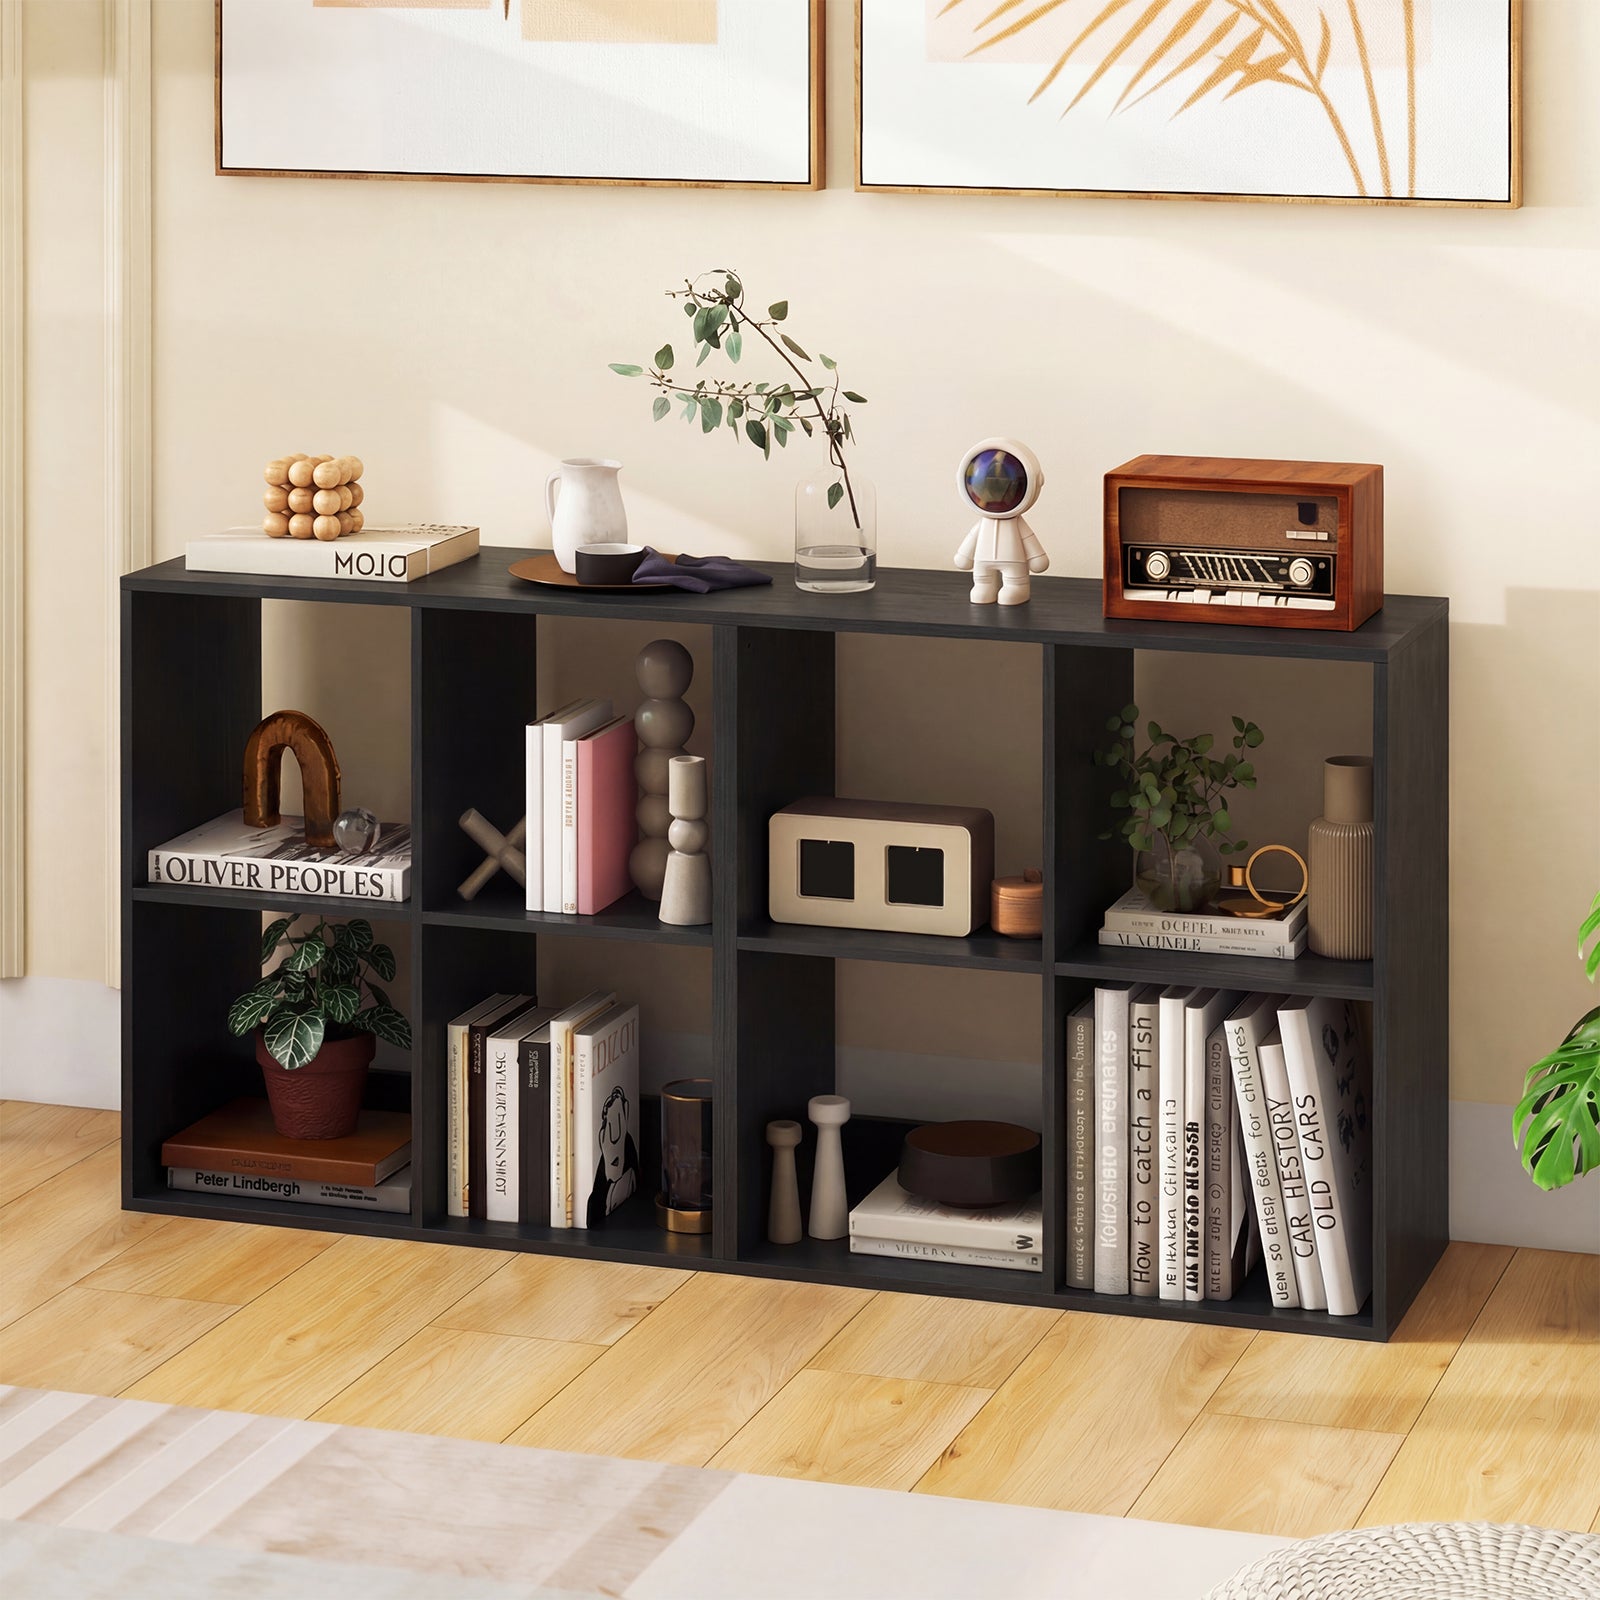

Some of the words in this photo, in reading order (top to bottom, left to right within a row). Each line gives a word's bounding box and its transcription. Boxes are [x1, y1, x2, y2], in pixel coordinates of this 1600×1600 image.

[165, 857, 263, 889] OLIVER
[270, 864, 384, 898] PEOPLES
[1132, 1016, 1152, 1071] fish
[1136, 1088, 1151, 1101] a
[1248, 1113, 1263, 1139] for
[1296, 1094, 1324, 1161] CARS
[1132, 1116, 1152, 1185] catch
[195, 1172, 229, 1187] Peter
[233, 1176, 300, 1197] Lindbergh
[1311, 1180, 1336, 1230] OLD
[1134, 1200, 1151, 1225] to
[1289, 1215, 1314, 1258] CAR
[1133, 1241, 1151, 1283] How
